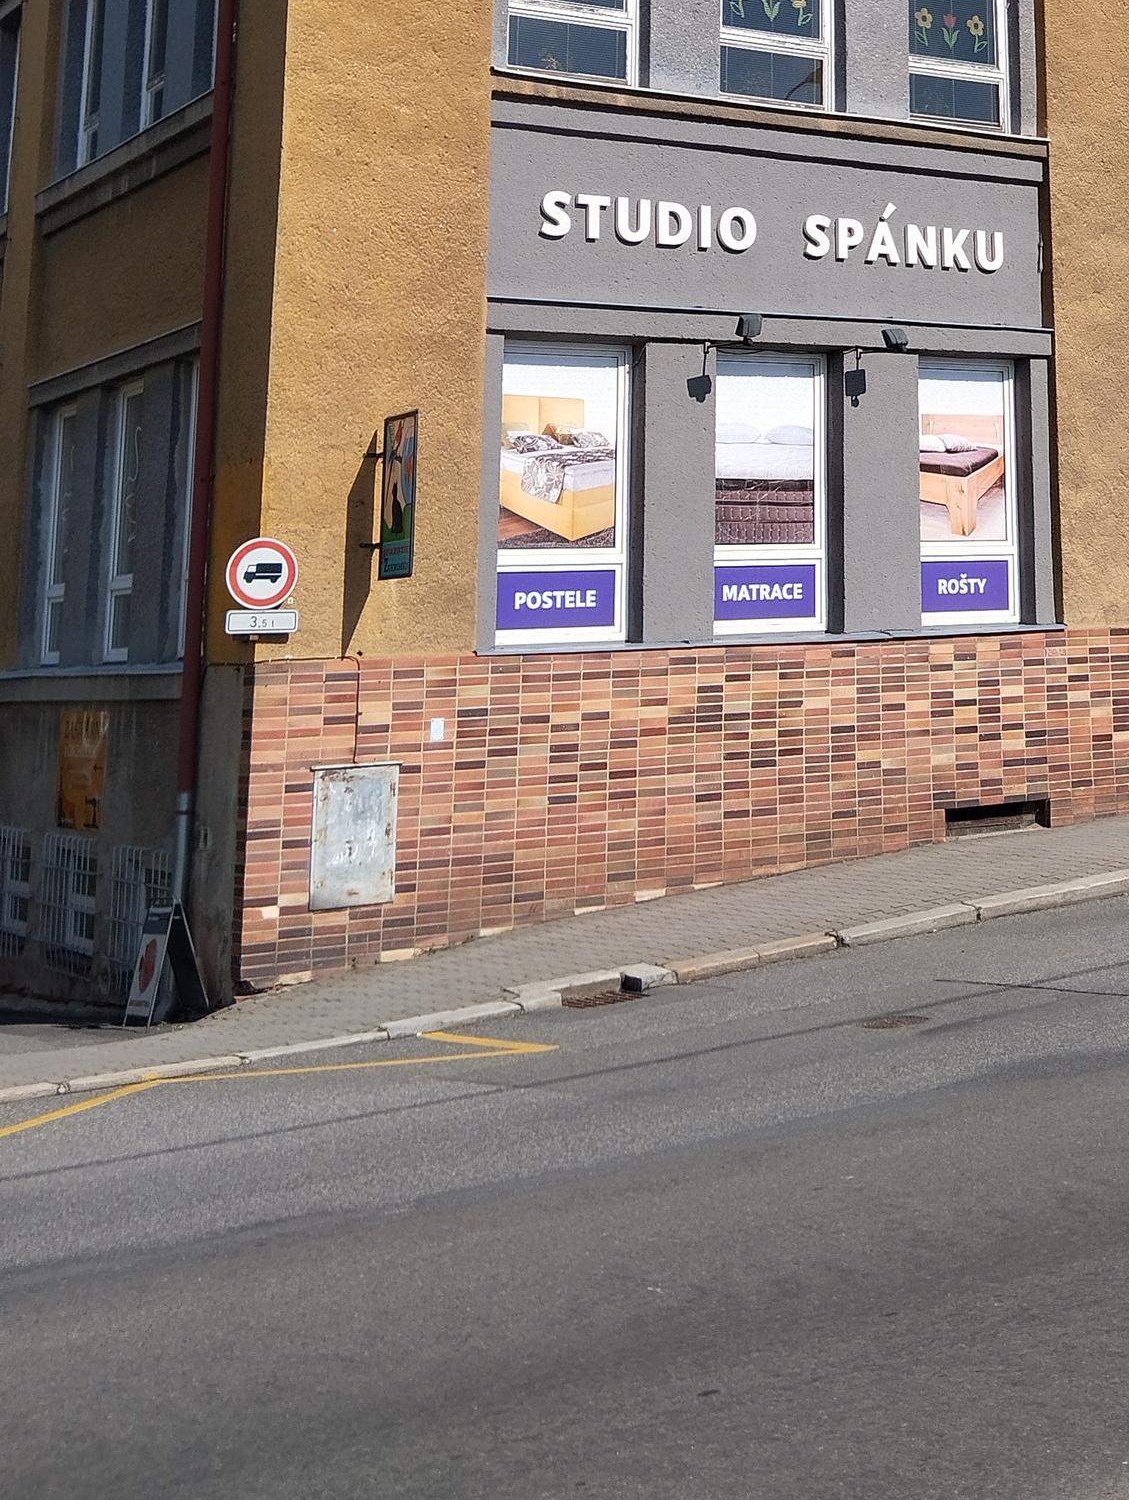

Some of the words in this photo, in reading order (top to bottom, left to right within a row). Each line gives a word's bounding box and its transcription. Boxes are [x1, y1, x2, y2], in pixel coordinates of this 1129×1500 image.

[540, 190, 758, 257] STUDIO
[804, 202, 1005, 274] SPÁNKU
[722, 583, 803, 603] MATRACE
[937, 573, 987, 596] ROŠTY
[513, 588, 597, 611] POSTELE
